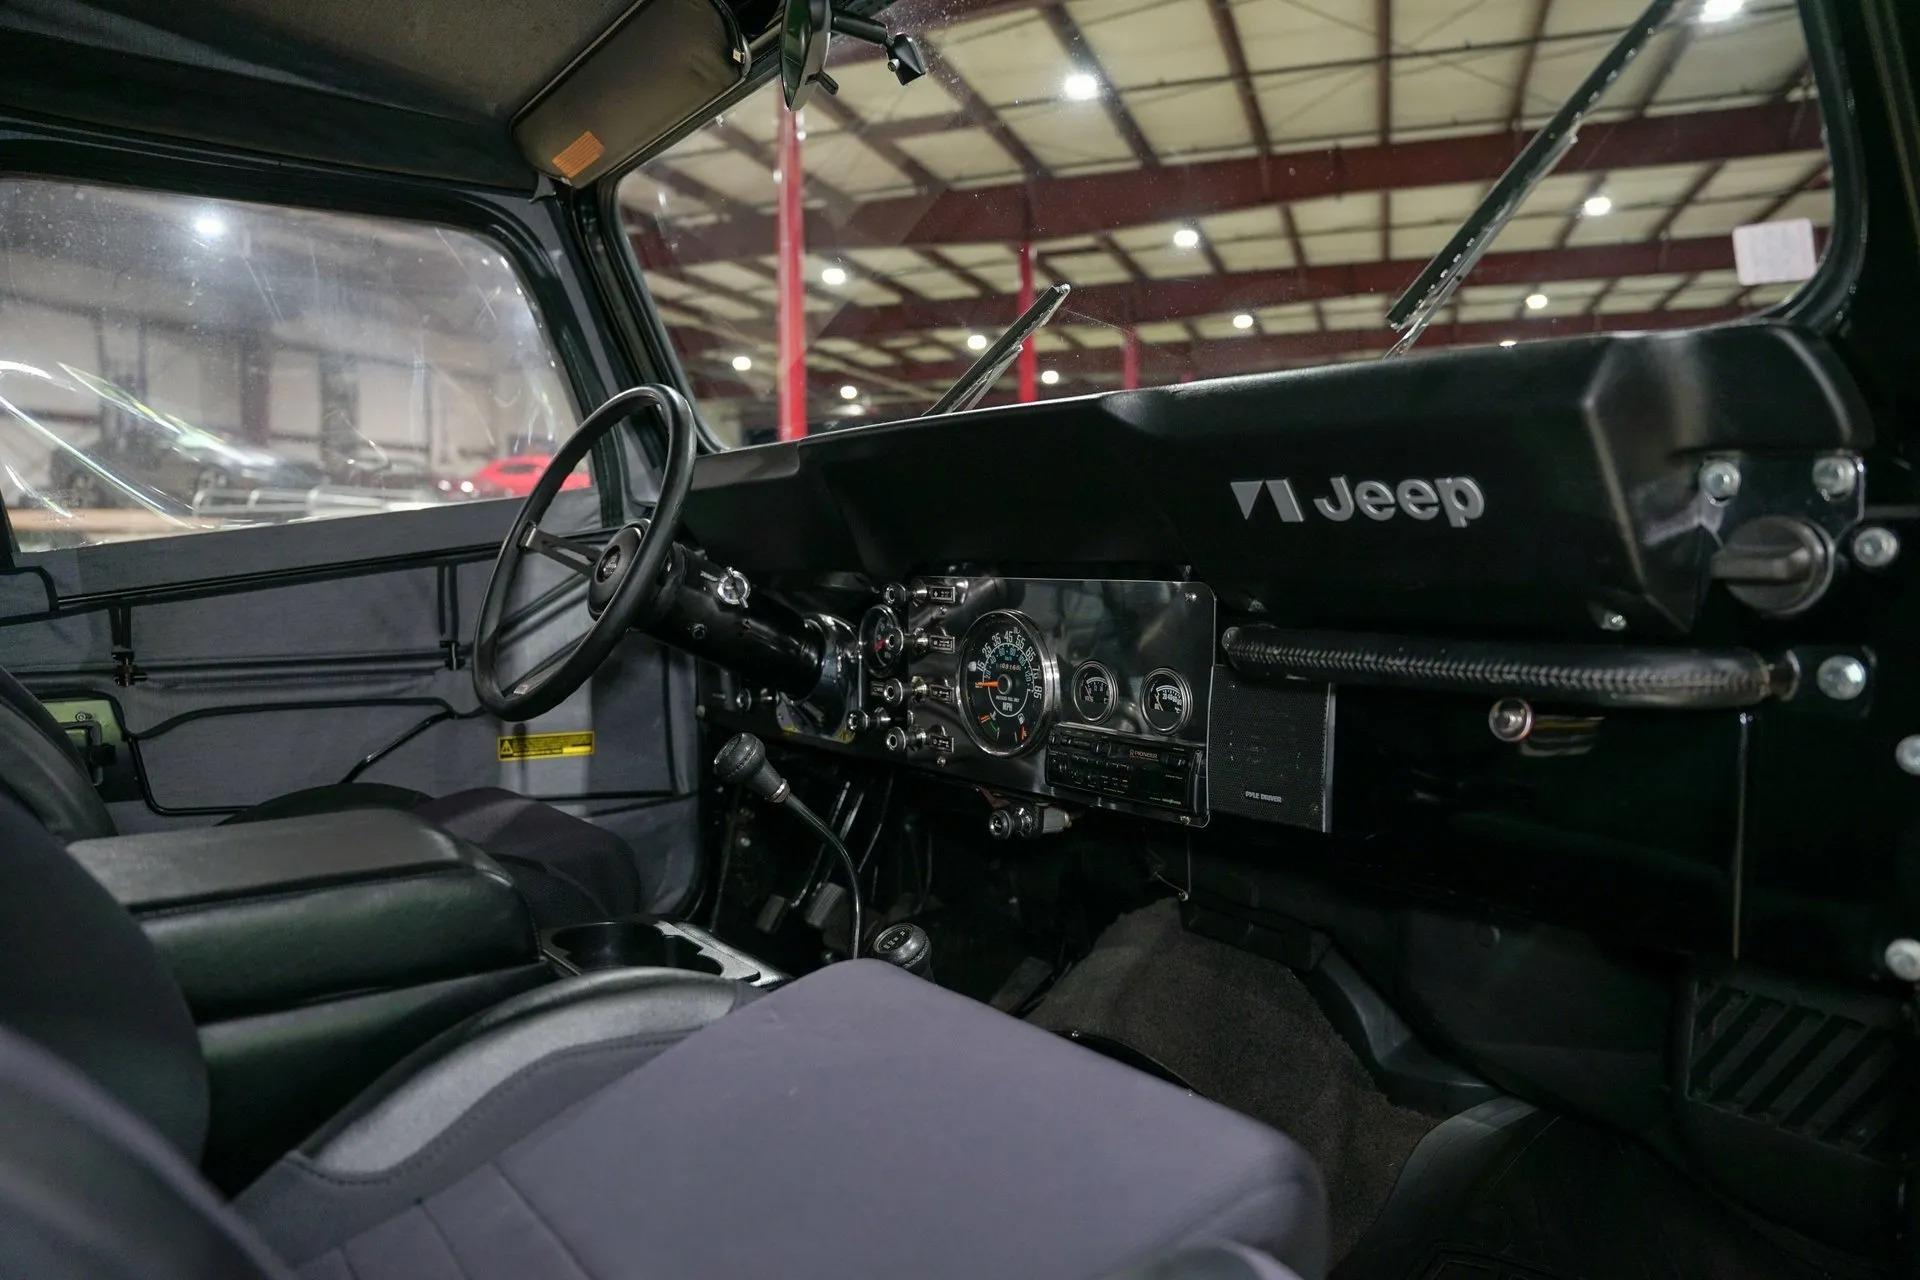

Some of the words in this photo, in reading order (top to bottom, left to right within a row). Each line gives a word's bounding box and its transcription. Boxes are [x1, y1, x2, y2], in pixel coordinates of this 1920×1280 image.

[1313, 475, 1486, 528] Jeep
[991, 632, 1001, 647] 35
[1004, 630, 1013, 643] 45
[1015, 634, 1026, 650] 55
[982, 642, 992, 659] 25
[1025, 646, 1036, 662] 65
[976, 659, 986, 672] 15
[1033, 685, 1043, 700] 85
[1134, 750, 1159, 759] PIONEER
[1245, 790, 1260, 800] PYLE
[1260, 793, 1282, 803] DRIVER
